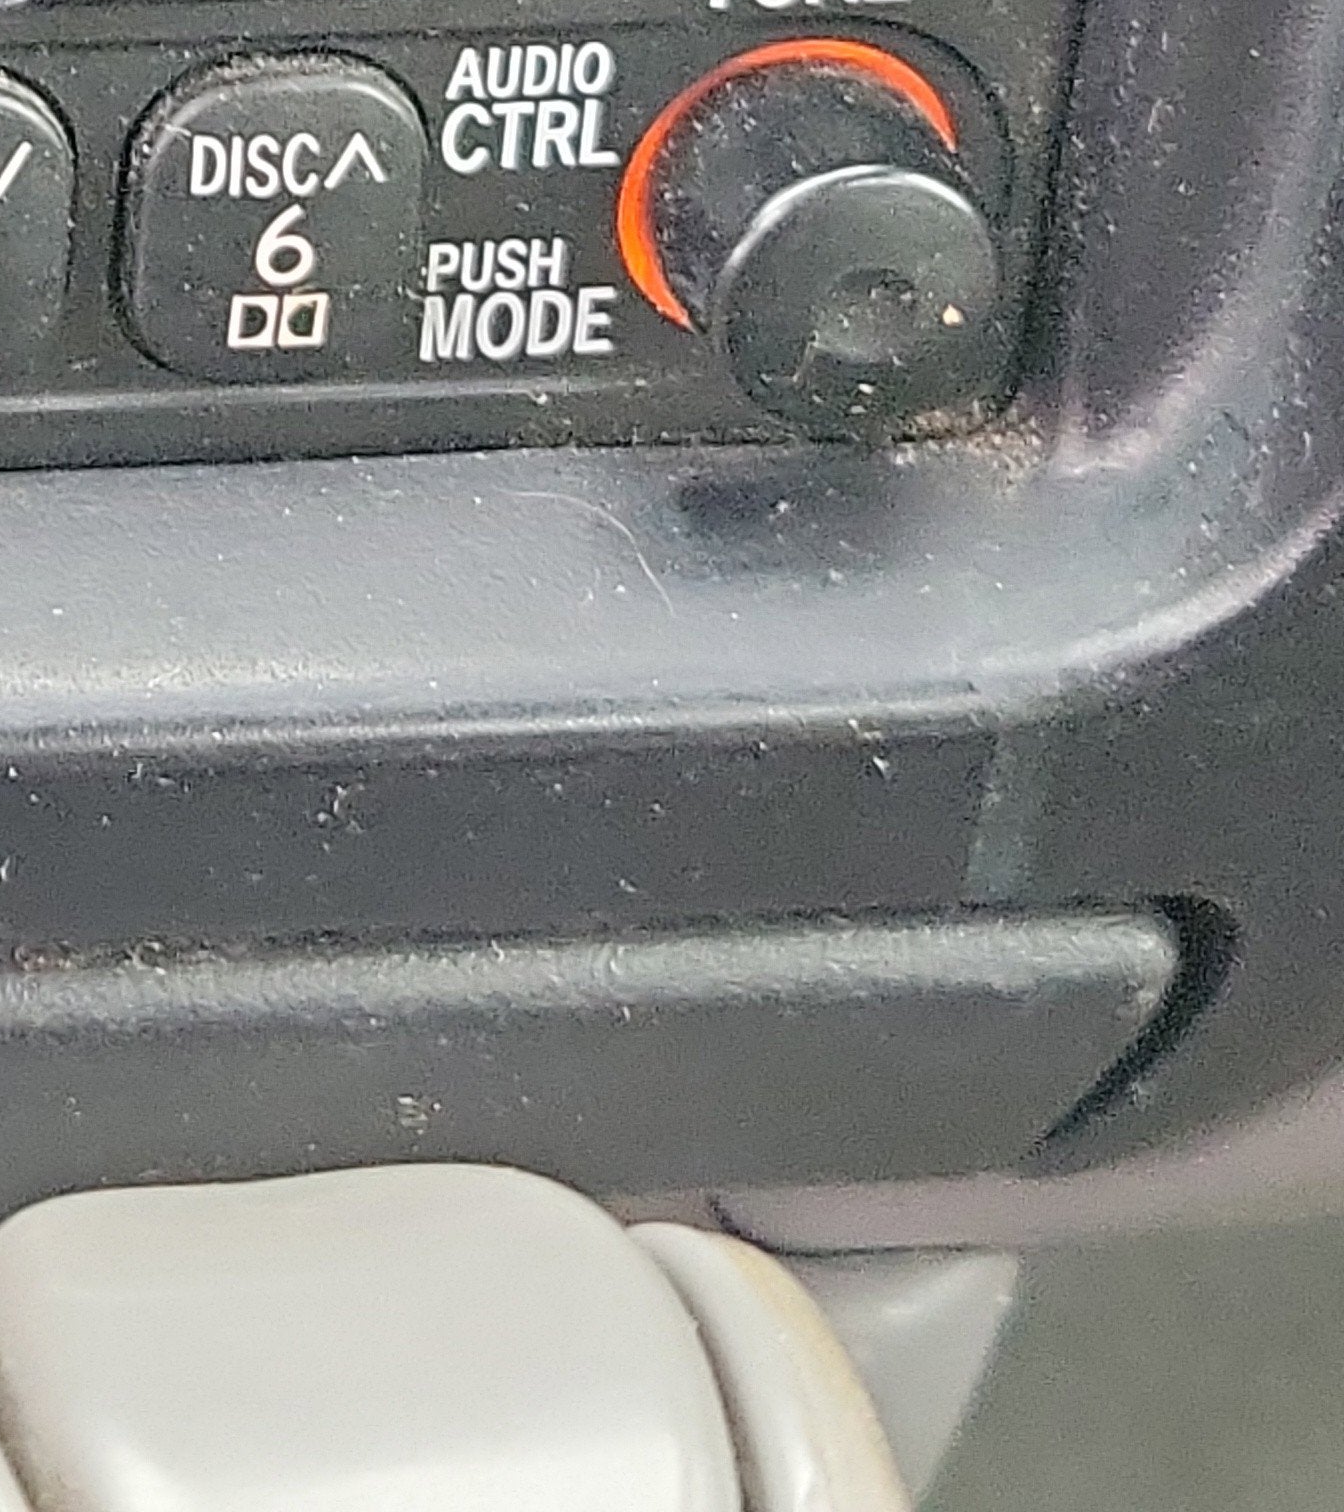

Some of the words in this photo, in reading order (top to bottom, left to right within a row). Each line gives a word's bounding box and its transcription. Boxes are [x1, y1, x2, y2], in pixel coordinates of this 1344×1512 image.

[445, 42, 613, 100] AUDIO
[190, 133, 321, 198] DISC
[441, 98, 619, 173] CTRL
[254, 203, 314, 286] 6
[428, 236, 566, 292] PUSH
[419, 287, 614, 362] MODE
